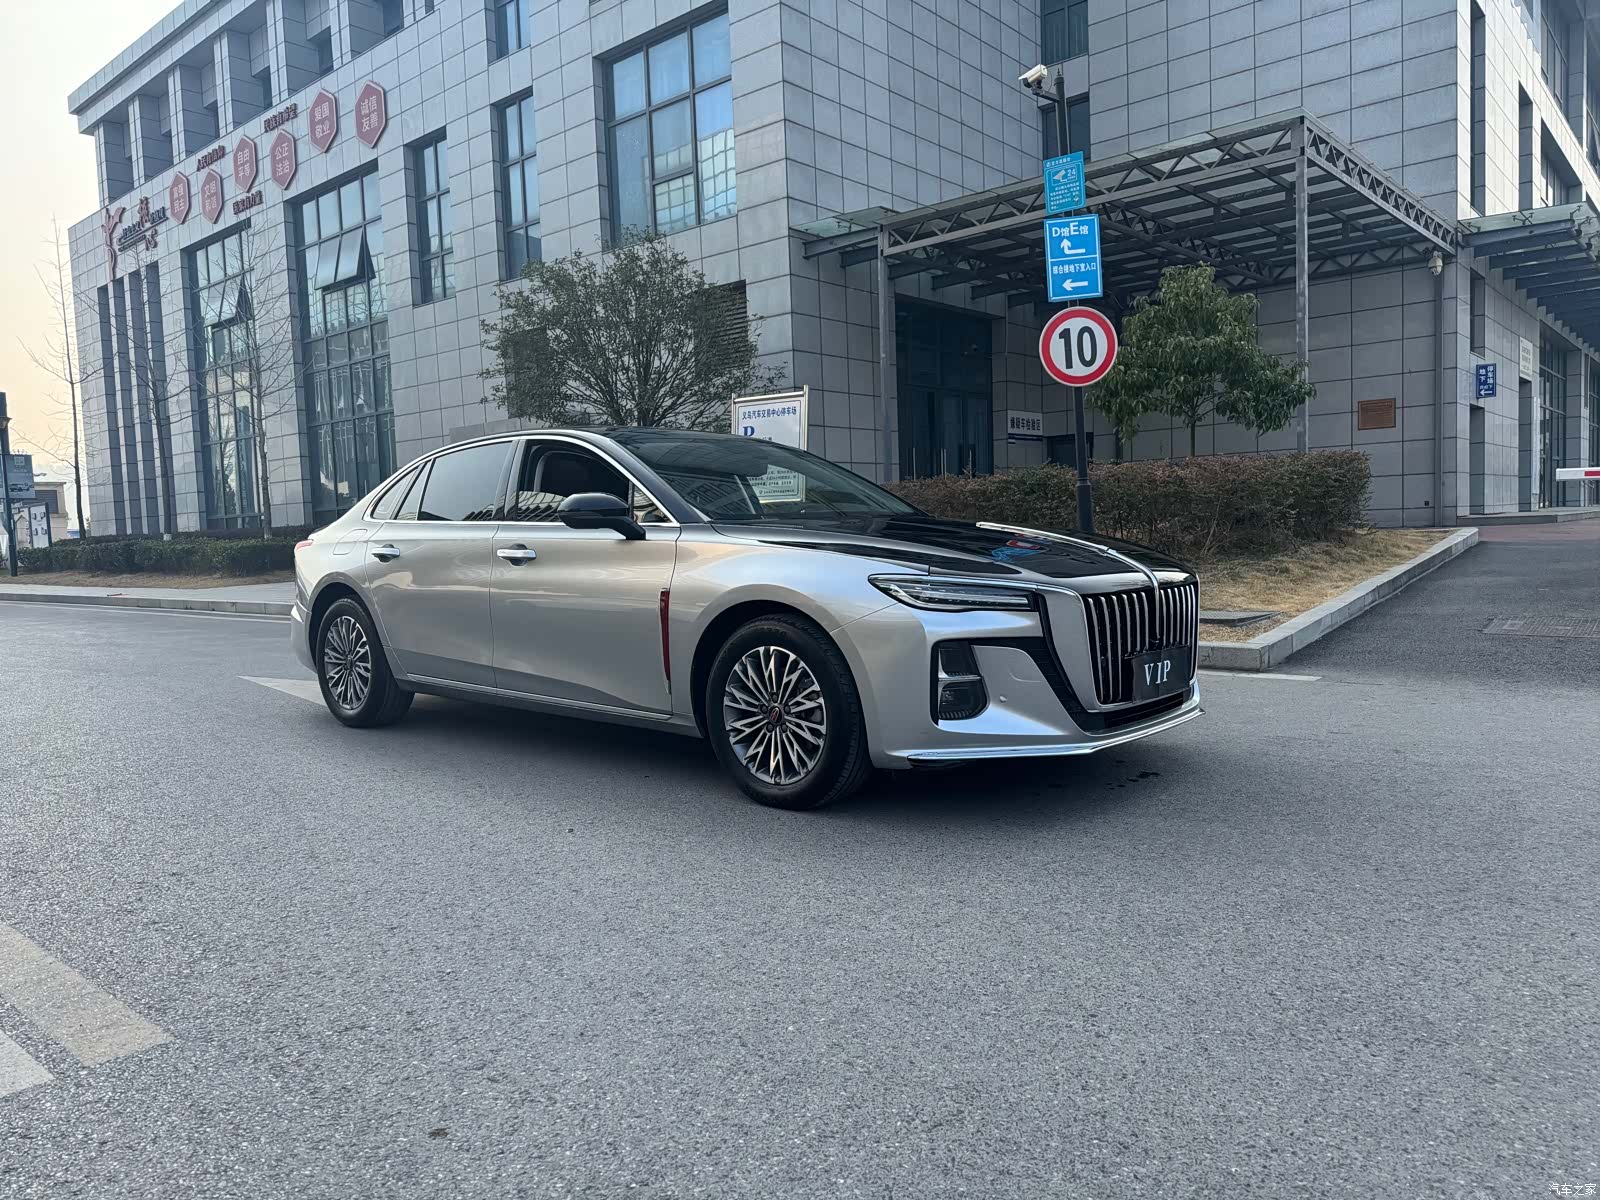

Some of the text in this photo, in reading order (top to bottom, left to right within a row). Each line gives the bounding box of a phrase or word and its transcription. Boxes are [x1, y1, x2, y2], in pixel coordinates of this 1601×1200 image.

[314, 101, 330, 121] 爱国
[360, 95, 377, 115] 诚信
[315, 119, 331, 139] 敬业
[361, 112, 378, 132] 友善
[237, 149, 250, 165] 自由
[275, 142, 289, 160] 公正
[238, 163, 251, 181] 平等
[276, 159, 290, 177] 法治
[173, 198, 185, 213] 民主
[1052, 221, 1089, 237] D馆E馆
[1058, 325, 1098, 370] 10
[742, 405, 797, 420] 义乌汽车交易中心停车场
[1144, 659, 1171, 686] VIP
